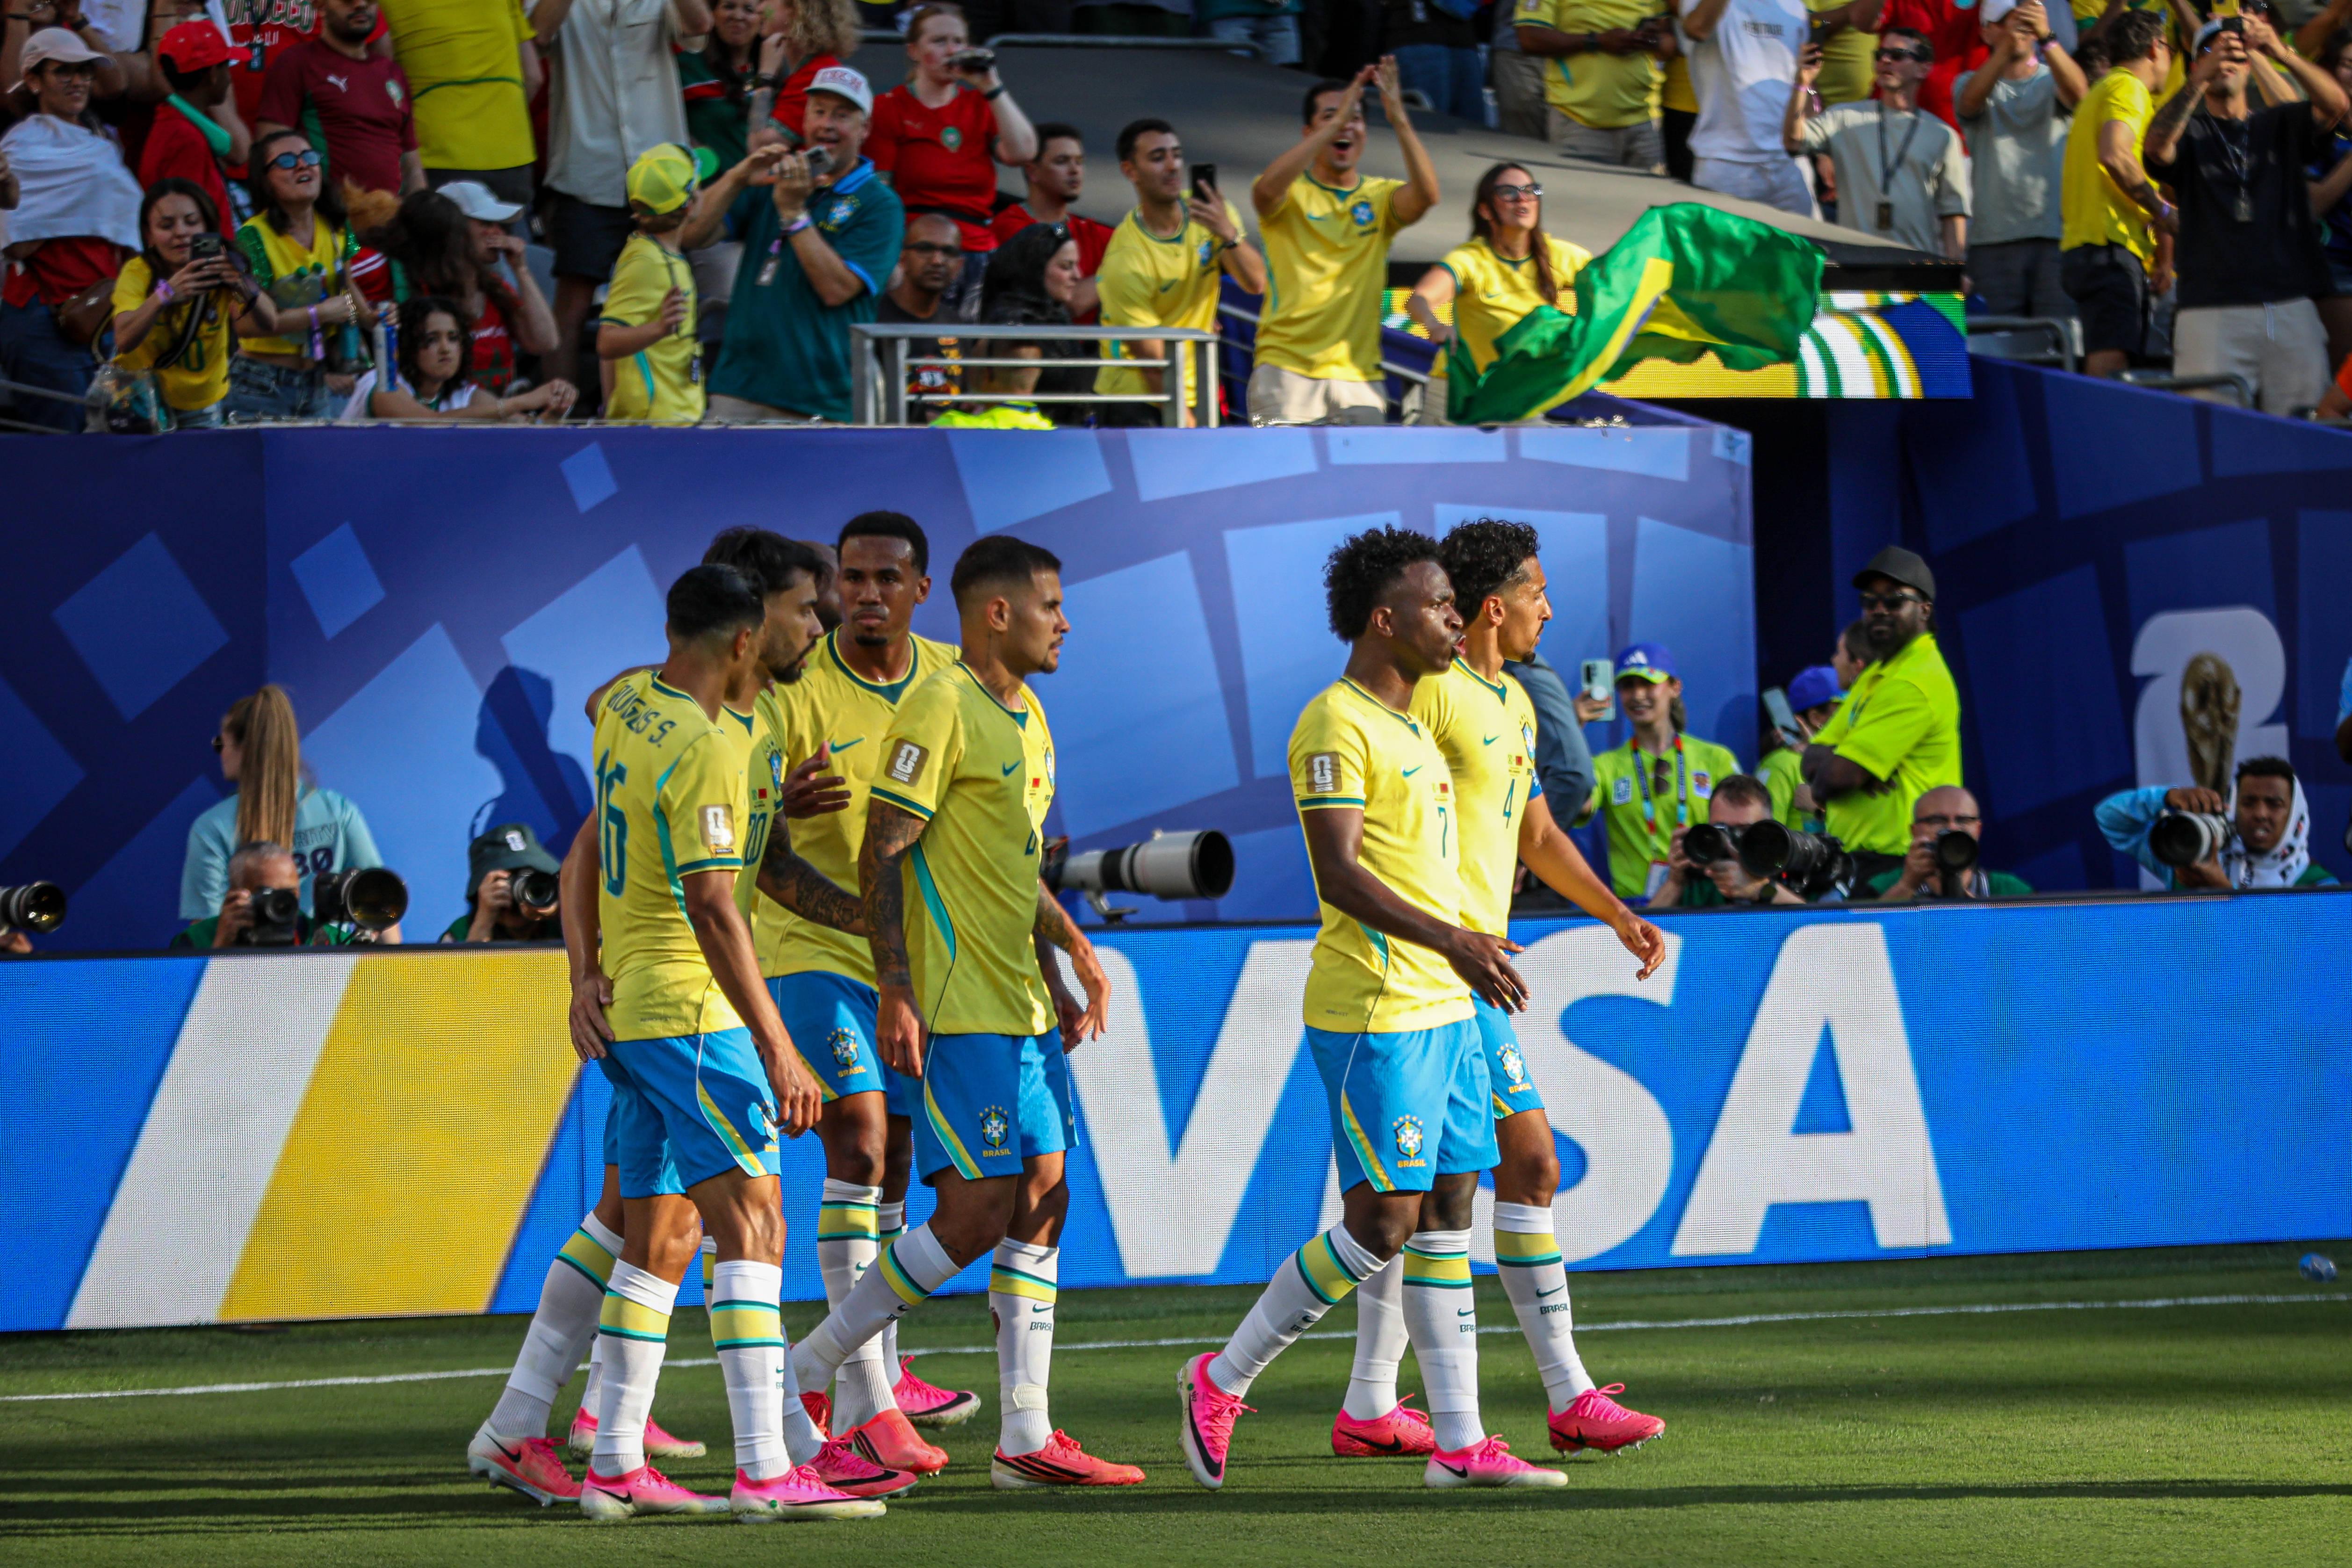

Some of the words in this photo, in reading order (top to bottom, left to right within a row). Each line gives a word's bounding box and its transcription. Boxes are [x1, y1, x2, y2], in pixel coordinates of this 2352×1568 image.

[222, 0, 318, 34] OROCCO
[1502, 778, 1515, 829] 4
[294, 822, 339, 846] RITY
[596, 748, 628, 898] 16
[1437, 806, 1448, 859] 7
[838, 1066, 866, 1078] BRASIL
[1054, 922, 1953, 1278] VSA
[983, 1148, 1012, 1157] BRASIL
[1398, 1159, 1427, 1168] BRASIL
[1540, 1303, 1569, 1315] BRASIL
